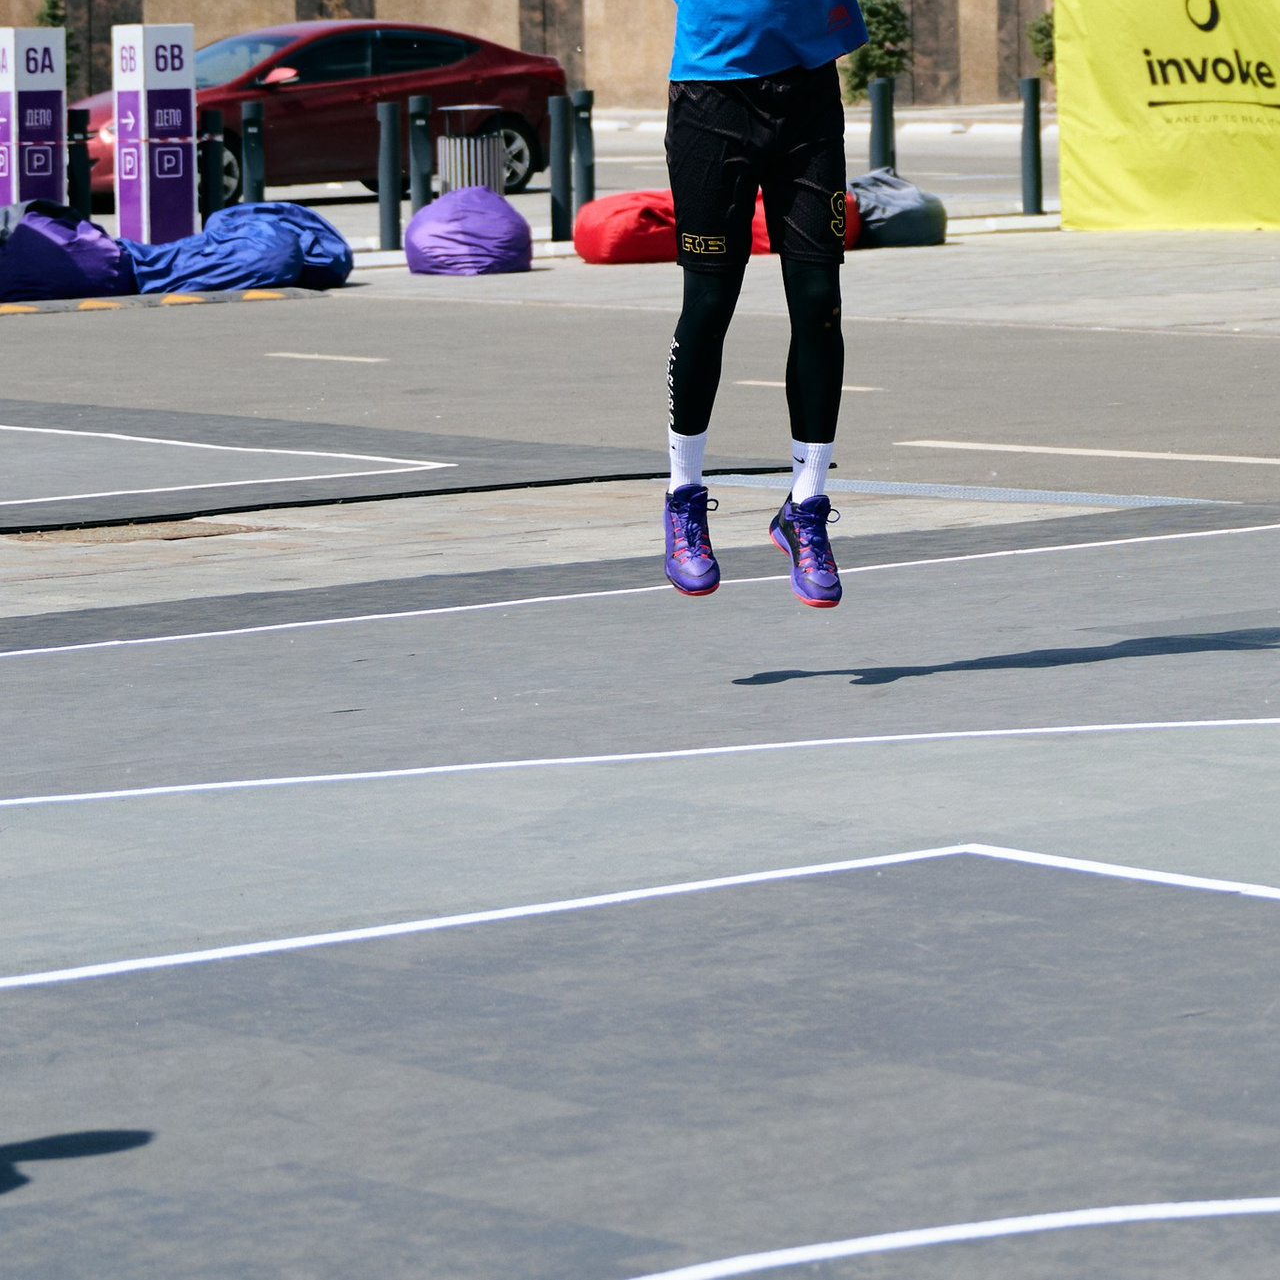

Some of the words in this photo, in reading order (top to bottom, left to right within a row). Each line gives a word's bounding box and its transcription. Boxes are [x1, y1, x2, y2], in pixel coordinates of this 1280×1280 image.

[25, 47, 55, 74] 6A
[120, 45, 137, 73] 6B
[154, 43, 184, 72] 6B
[1143, 47, 1277, 88] invoke
[1165, 115, 1201, 125] WAKE
[1205, 114, 1219, 123] UP
